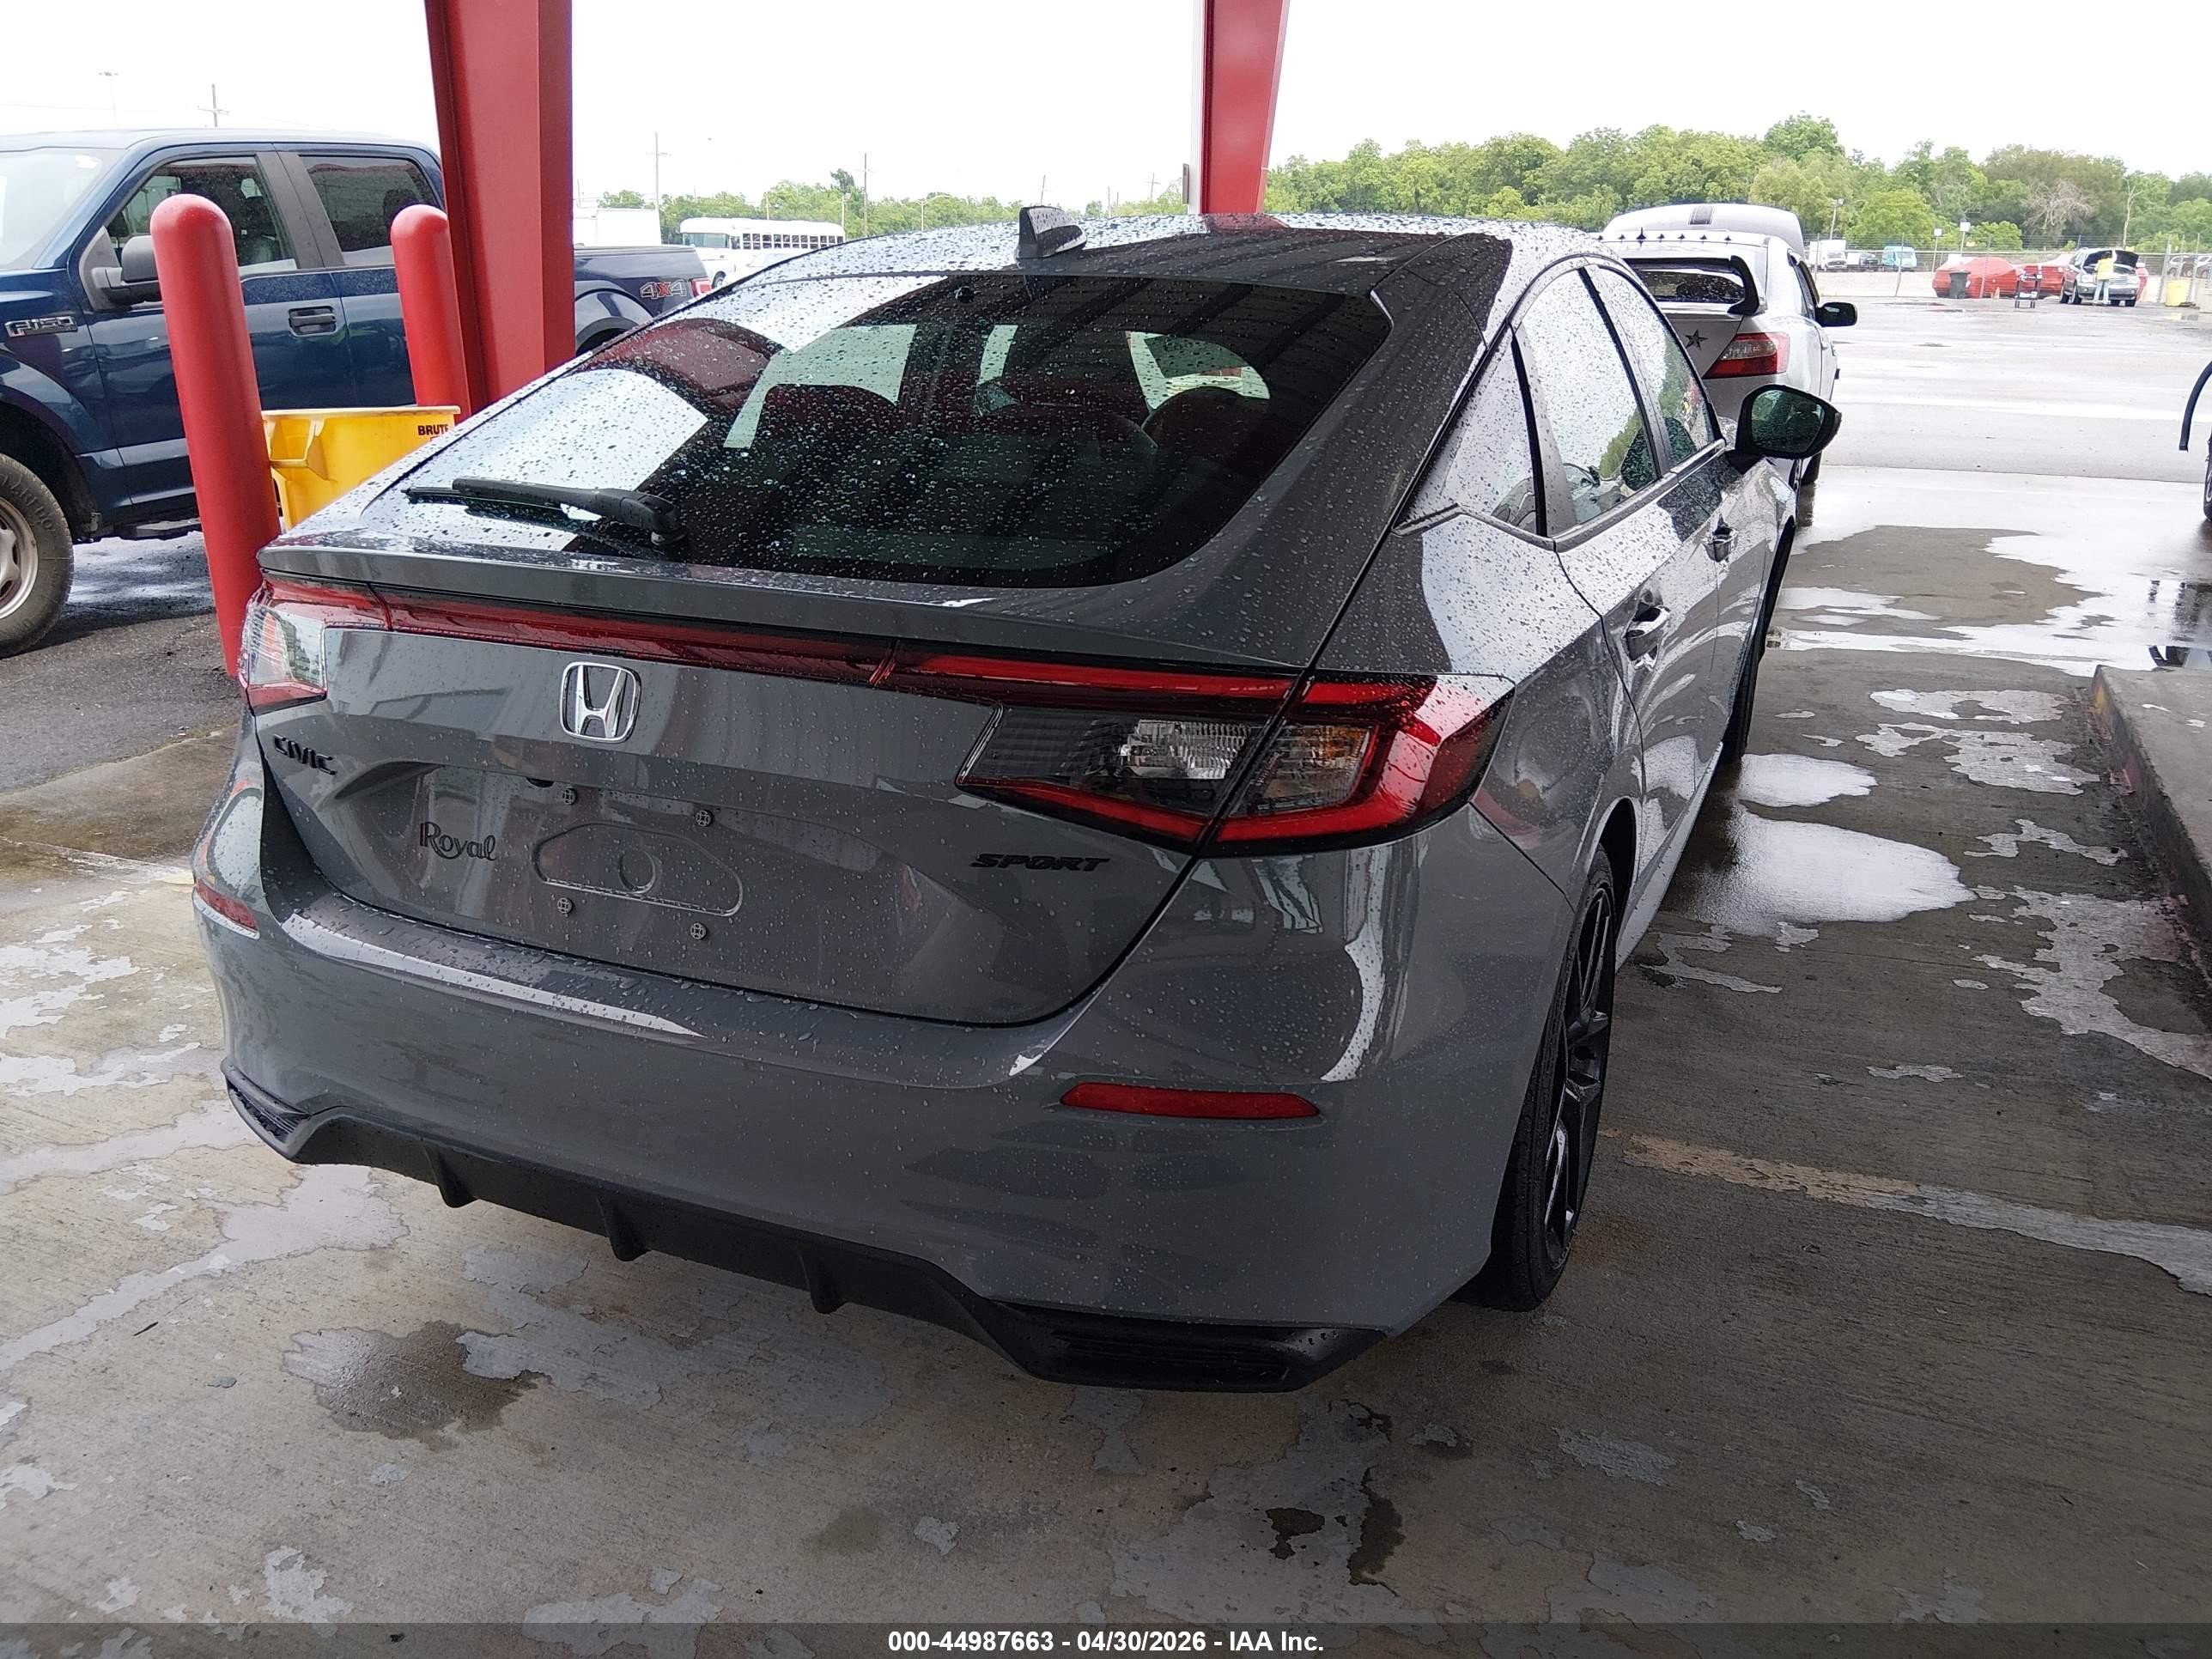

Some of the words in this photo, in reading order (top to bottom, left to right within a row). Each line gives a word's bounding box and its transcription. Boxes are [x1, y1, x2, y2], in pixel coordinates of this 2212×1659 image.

[273, 733, 337, 775] CIVIC
[419, 821, 496, 861] Royal
[969, 853, 1110, 872] SPORT
